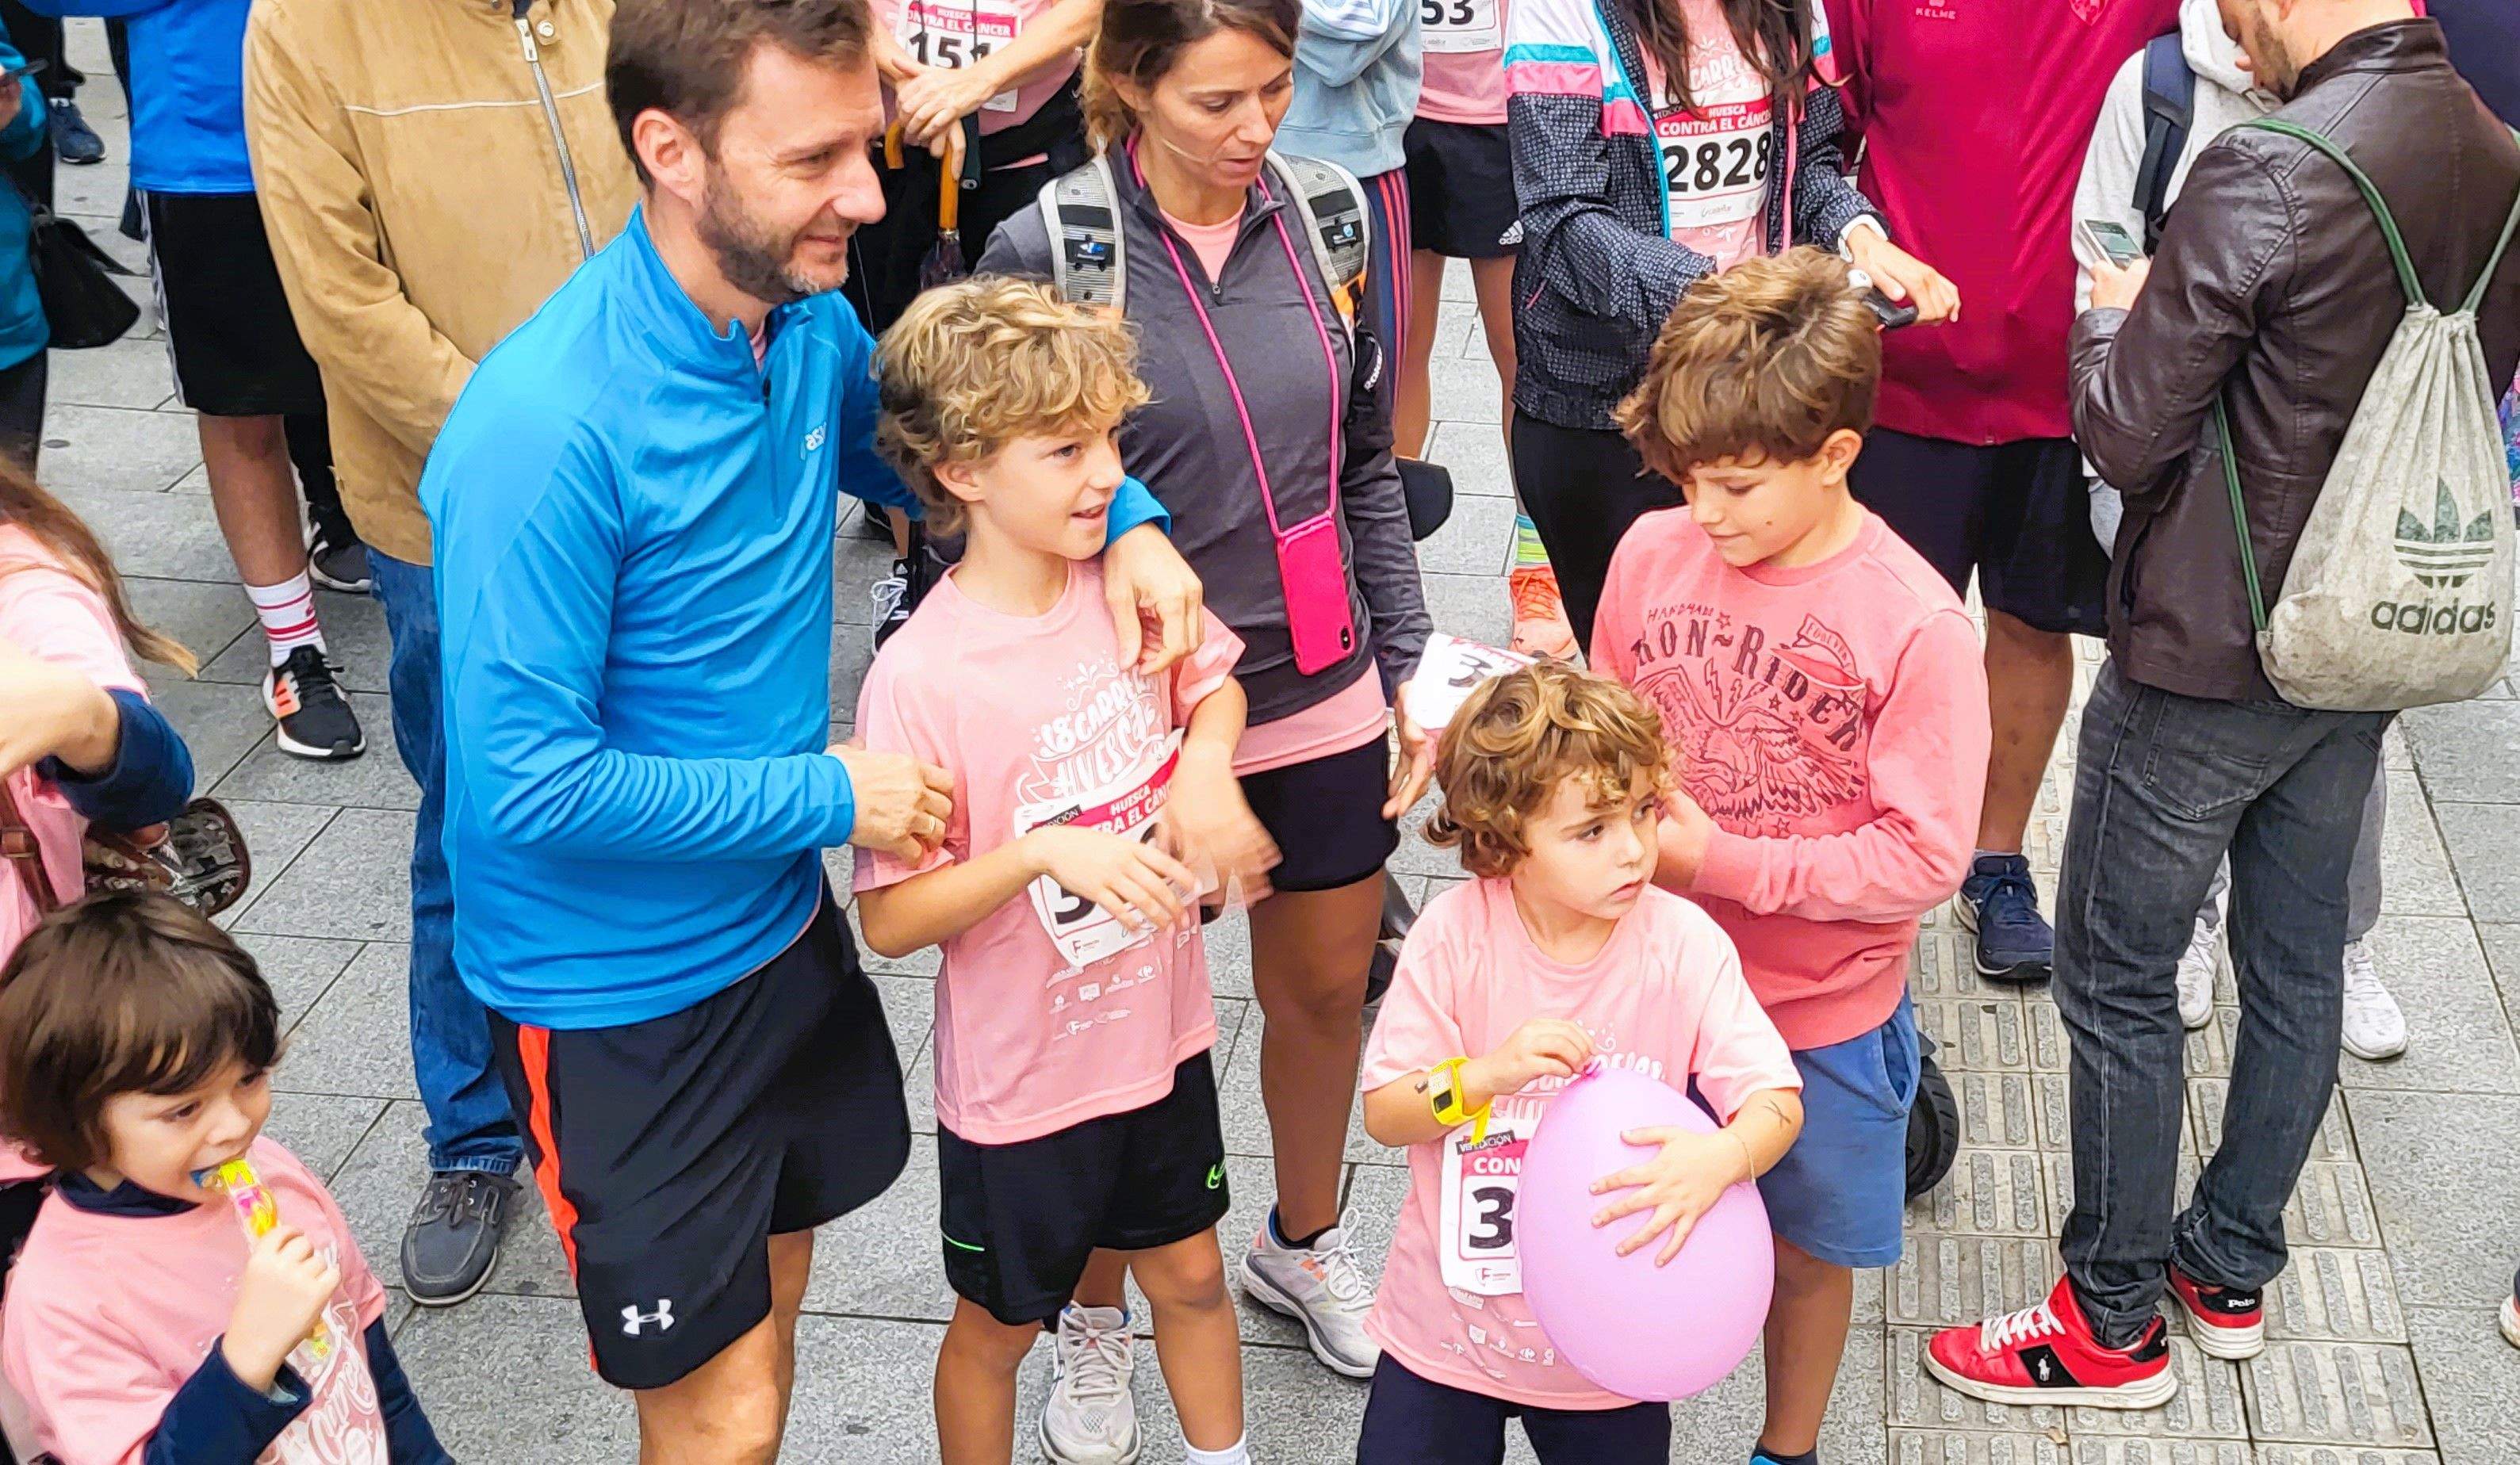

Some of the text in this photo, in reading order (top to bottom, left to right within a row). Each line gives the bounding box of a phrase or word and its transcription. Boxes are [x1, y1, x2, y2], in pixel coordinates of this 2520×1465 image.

[1915, 8, 1957, 20] KELME
[946, 19, 961, 31] EL
[1708, 104, 1747, 118] HUESCA
[1660, 119, 1718, 136] CONTRA
[1720, 118, 1735, 131] EL
[1662, 131, 1771, 193] 2828
[2371, 597, 2495, 635] adidas
[1111, 784, 1151, 816] HUESCA
[1128, 808, 1144, 824] EL
[1469, 1187, 1515, 1249] 3
[2227, 1298, 2256, 1308] Polo
